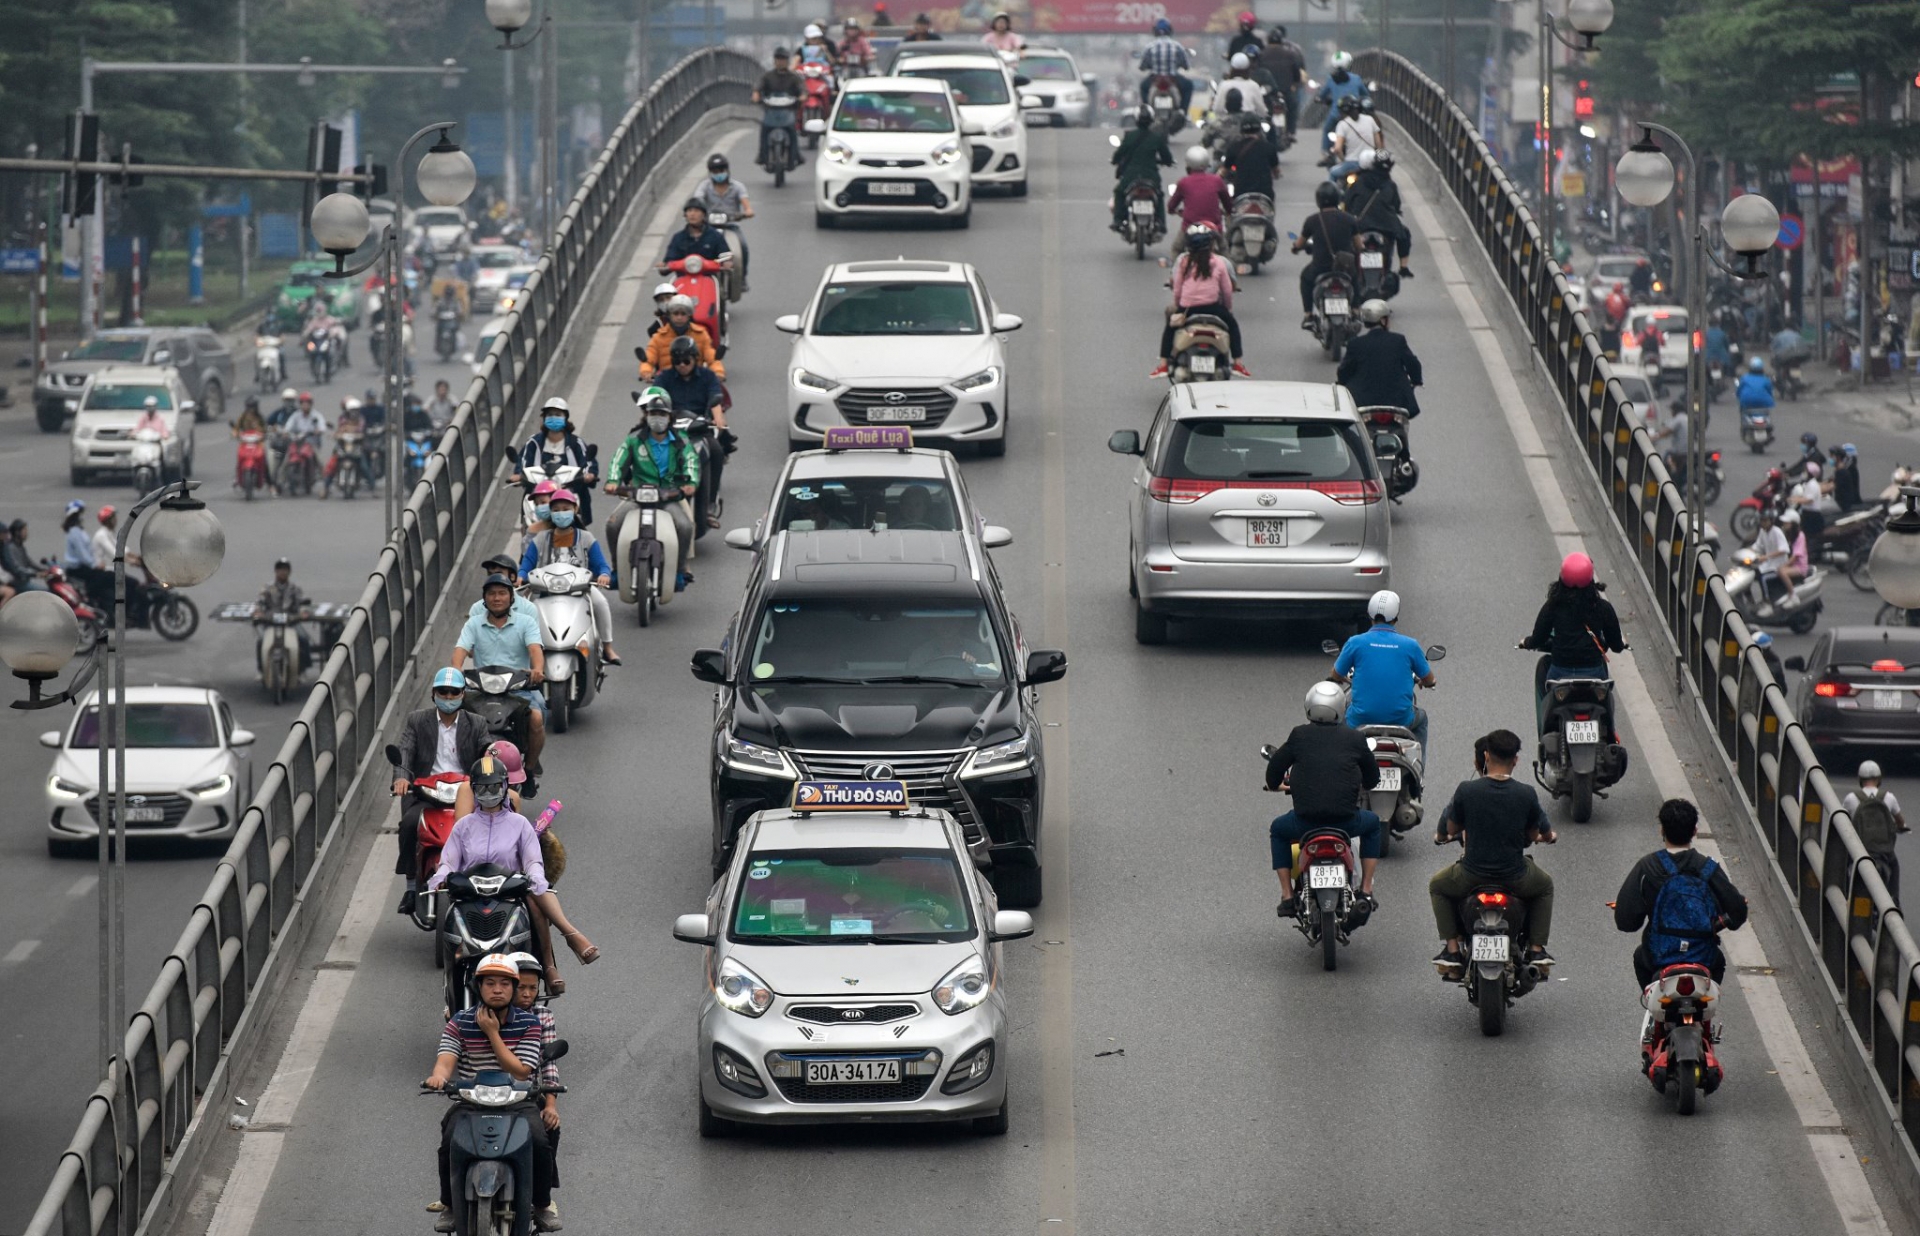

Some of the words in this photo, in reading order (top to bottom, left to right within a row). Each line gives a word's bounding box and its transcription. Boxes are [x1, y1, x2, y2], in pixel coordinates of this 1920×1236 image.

[1115, 2, 1166, 24] 2019
[869, 408, 924, 420] 30F-105.57
[831, 433, 854, 444] Taxi
[856, 430, 878, 444] Quê
[882, 430, 904, 447] Lụa
[1252, 520, 1283, 533] 80-291
[1254, 533, 1281, 545] NG-03
[1571, 722, 1593, 732] 29-F1
[1569, 732, 1597, 742] 400.89
[824, 787, 852, 803] THỦ
[854, 787, 875, 803] ĐÔ
[876, 789, 904, 803] SAO
[1315, 866, 1339, 876] 28-F1
[1313, 876, 1343, 887] 137.29
[1478, 937, 1503, 947] 29-V1
[1475, 948, 1506, 960] 327.54
[810, 1062, 897, 1081] 30A-341.74
